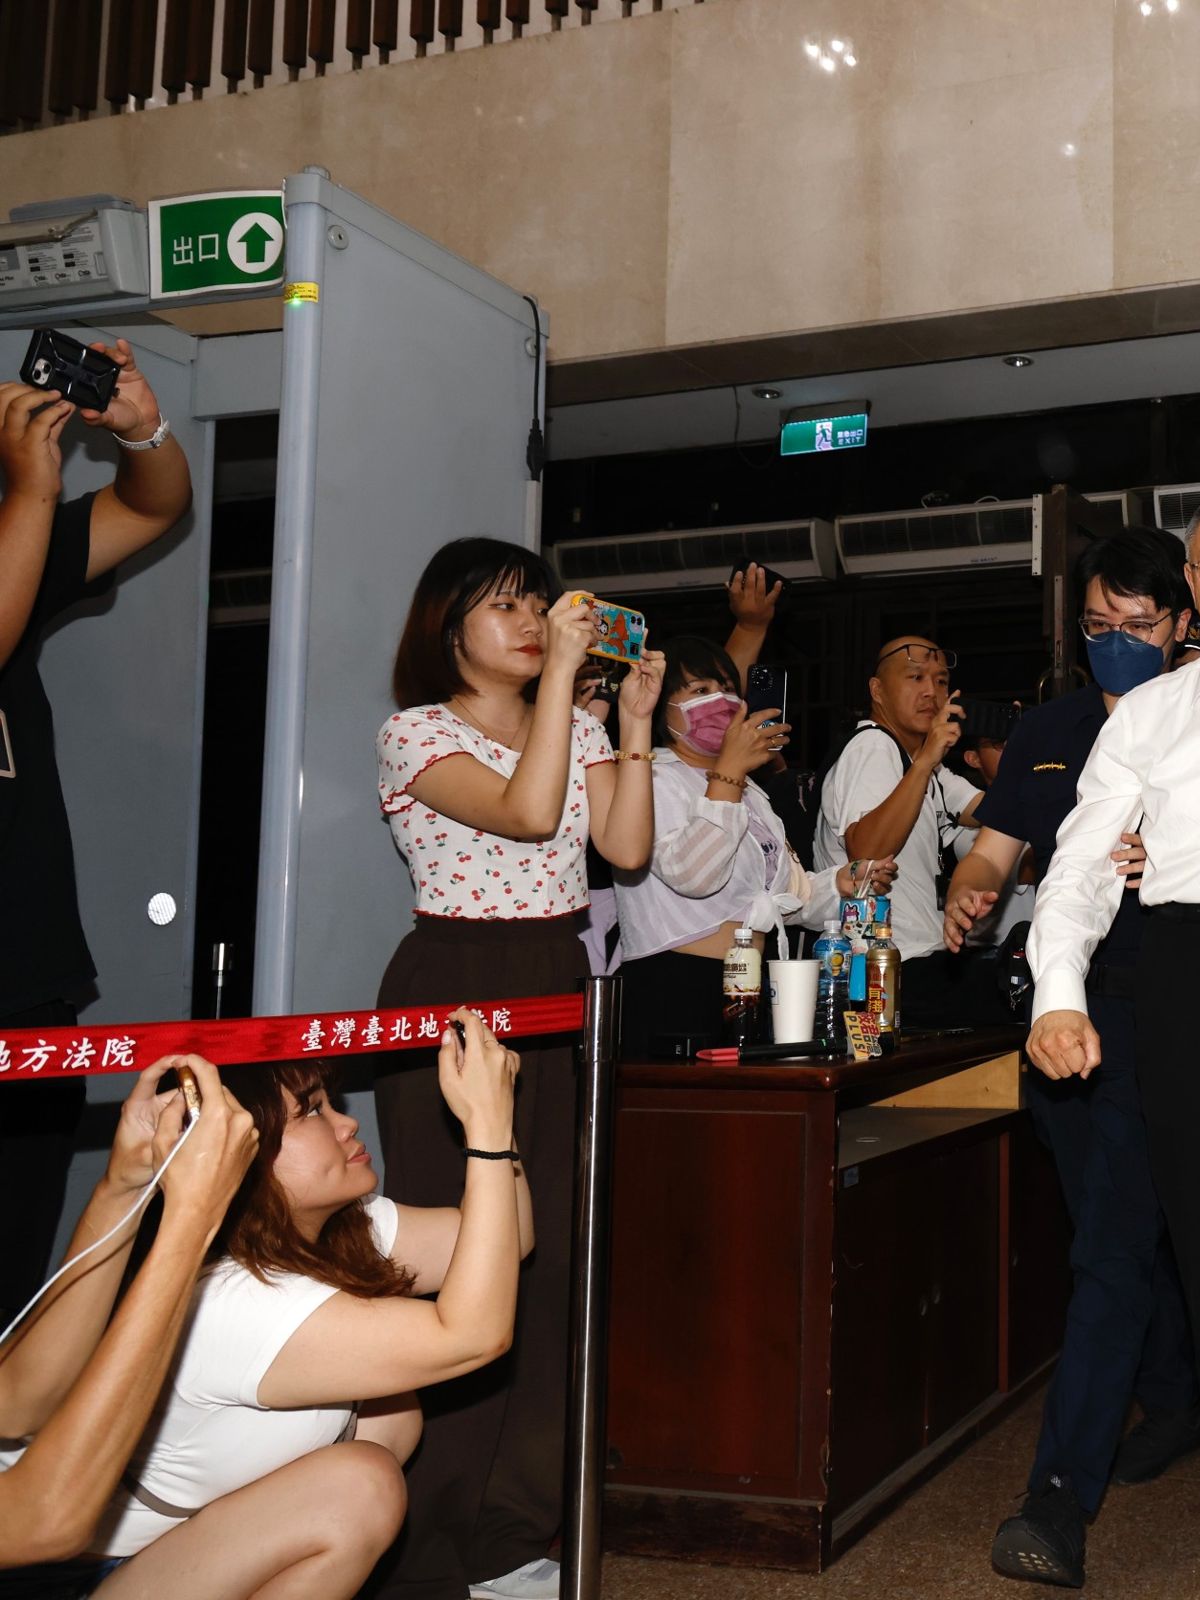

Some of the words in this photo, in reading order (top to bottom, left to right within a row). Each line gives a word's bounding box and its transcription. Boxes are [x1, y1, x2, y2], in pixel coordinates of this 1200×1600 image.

[173, 233, 219, 265] 出口
[838, 436, 861, 445] EXIT
[301, 1007, 512, 1052] 臺灣臺北地院
[846, 1014, 866, 1051] PLUS
